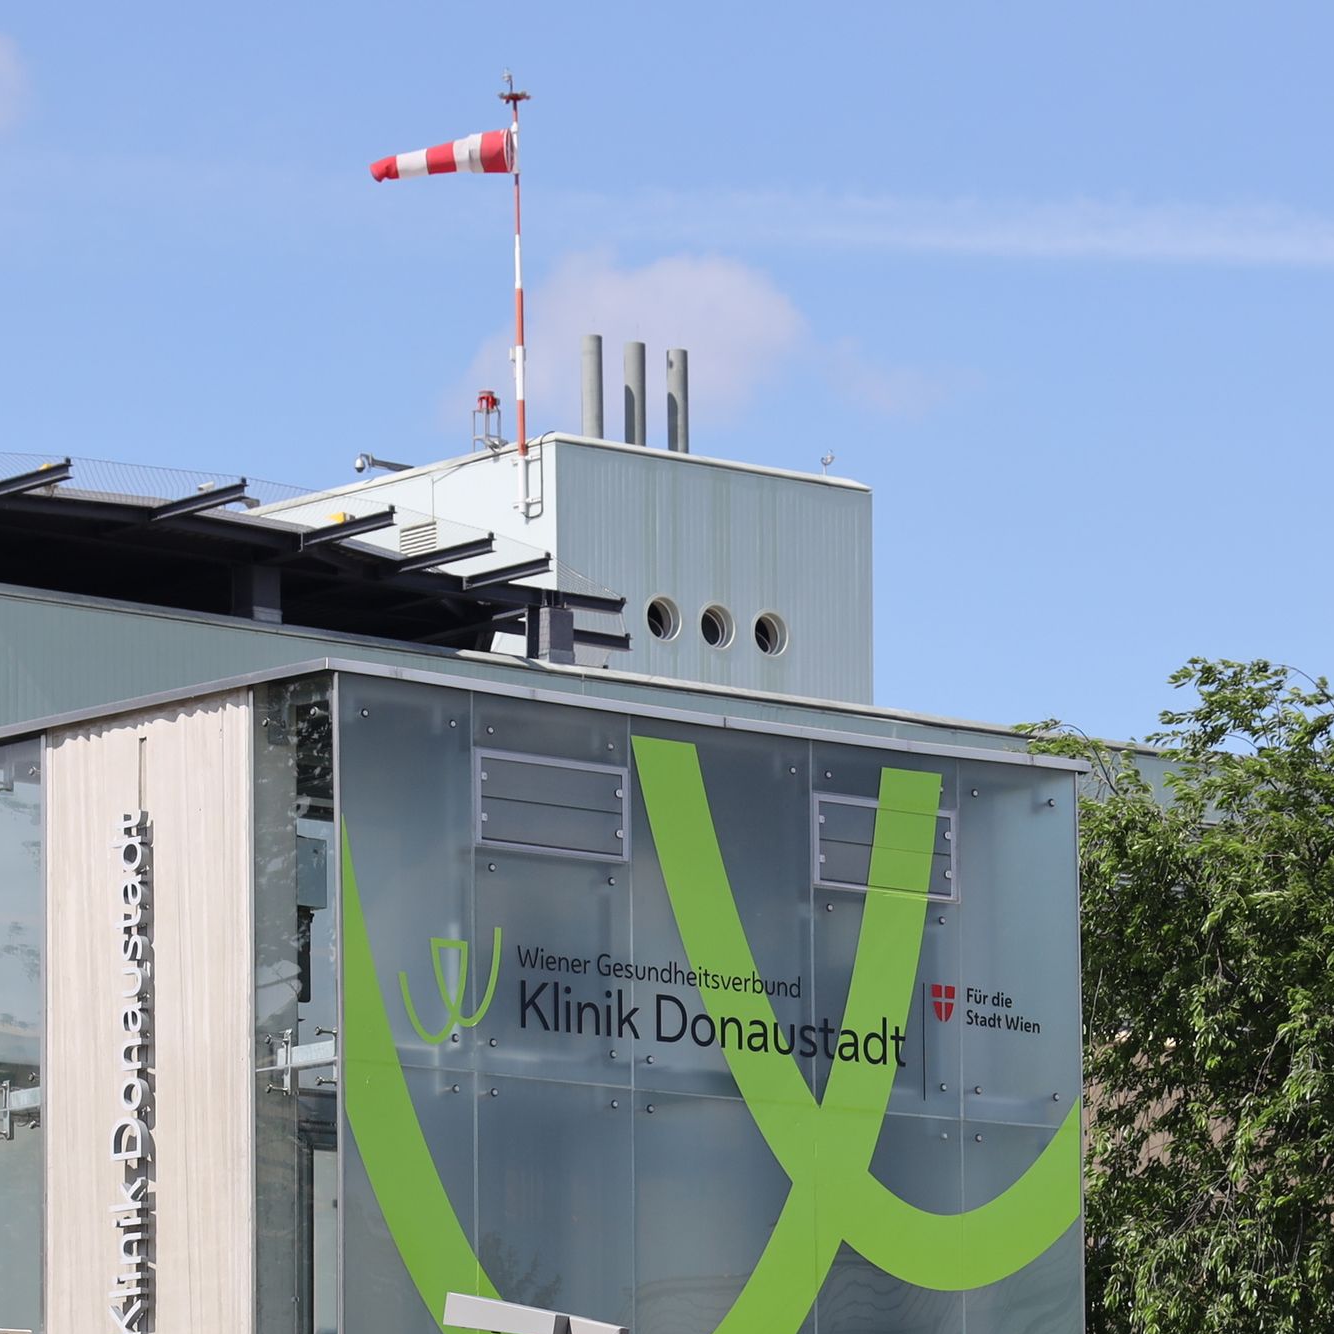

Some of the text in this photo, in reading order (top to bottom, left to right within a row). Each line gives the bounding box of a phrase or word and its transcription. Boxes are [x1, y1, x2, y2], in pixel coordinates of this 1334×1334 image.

[111, 810, 149, 1161] Donaustadt
[517, 945, 801, 998] Wiener Gesundheitsverbund
[966, 987, 1012, 1008] Für die
[520, 979, 906, 1067] Klinik Donaustadt
[966, 1009, 1041, 1034] Stadt Wien
